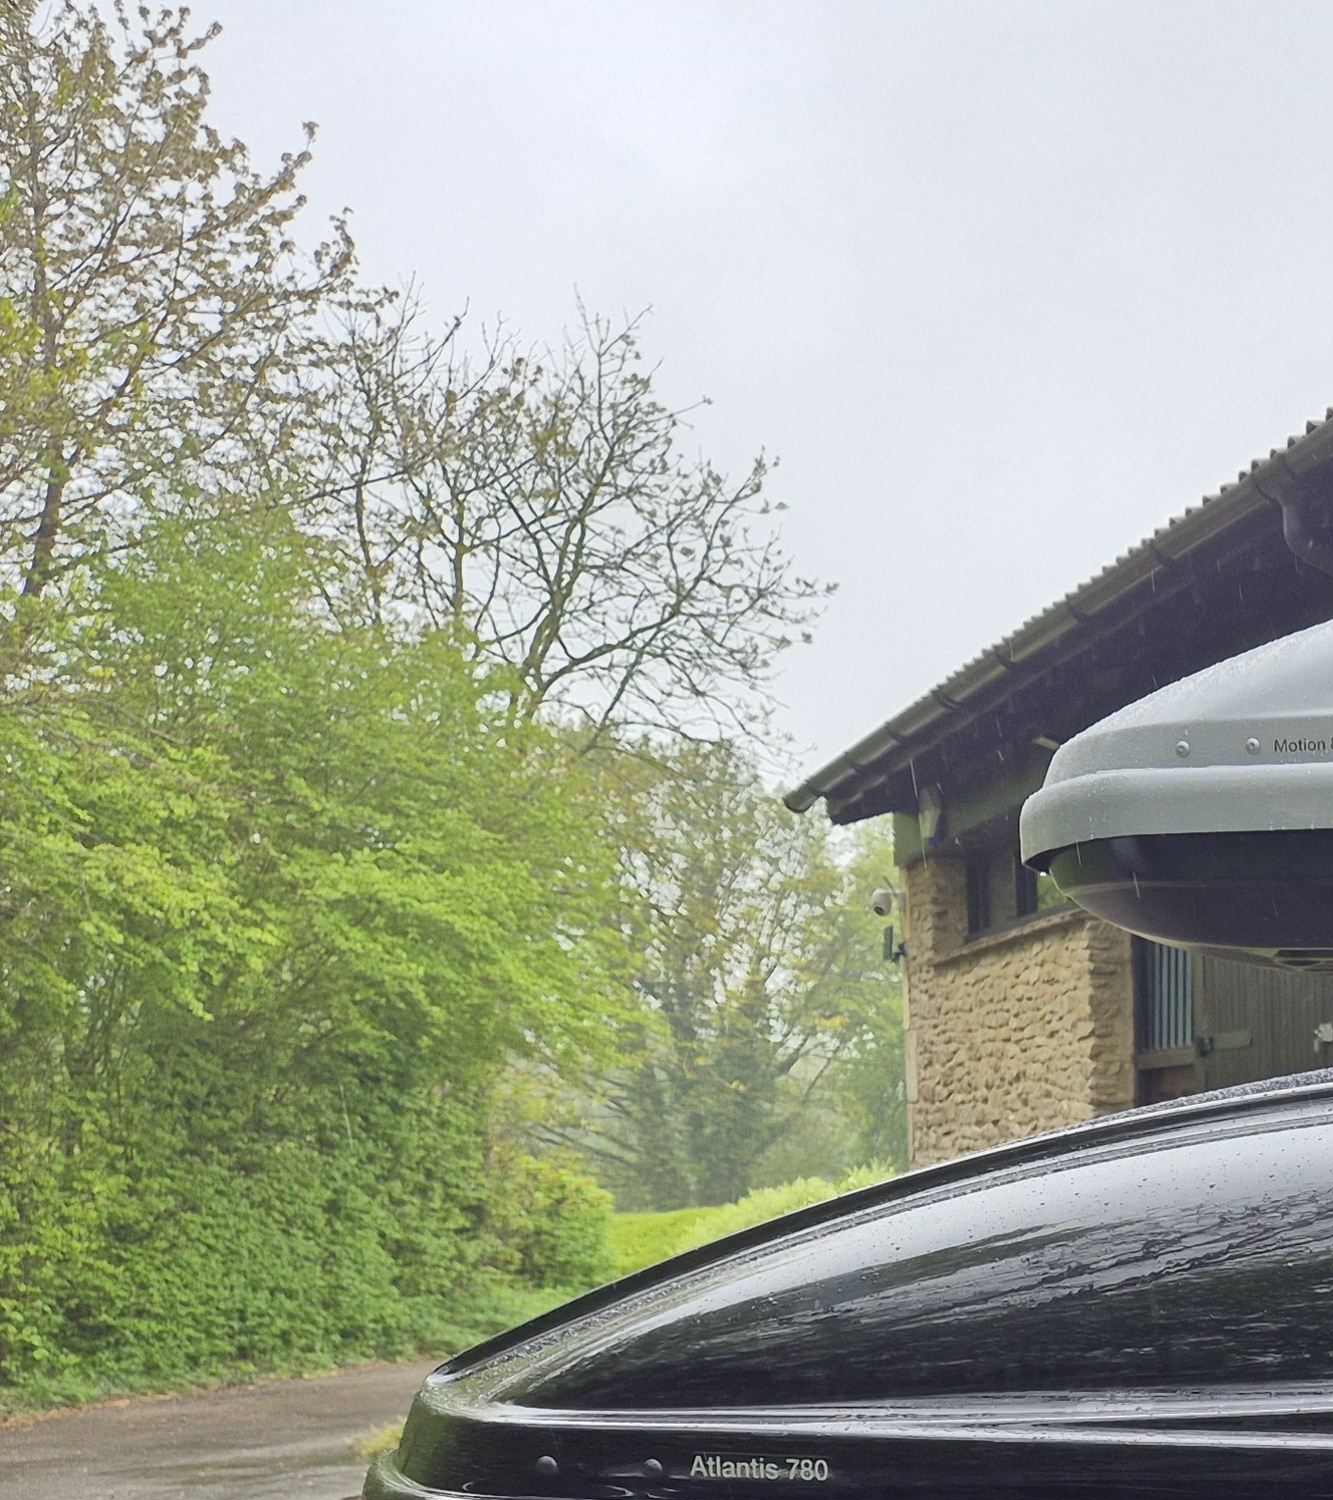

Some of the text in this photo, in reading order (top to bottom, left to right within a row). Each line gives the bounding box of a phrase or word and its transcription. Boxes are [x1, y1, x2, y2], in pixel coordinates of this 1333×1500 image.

[1273, 737, 1326, 753] Motion
[690, 1455, 829, 1482] Atlantis 780
